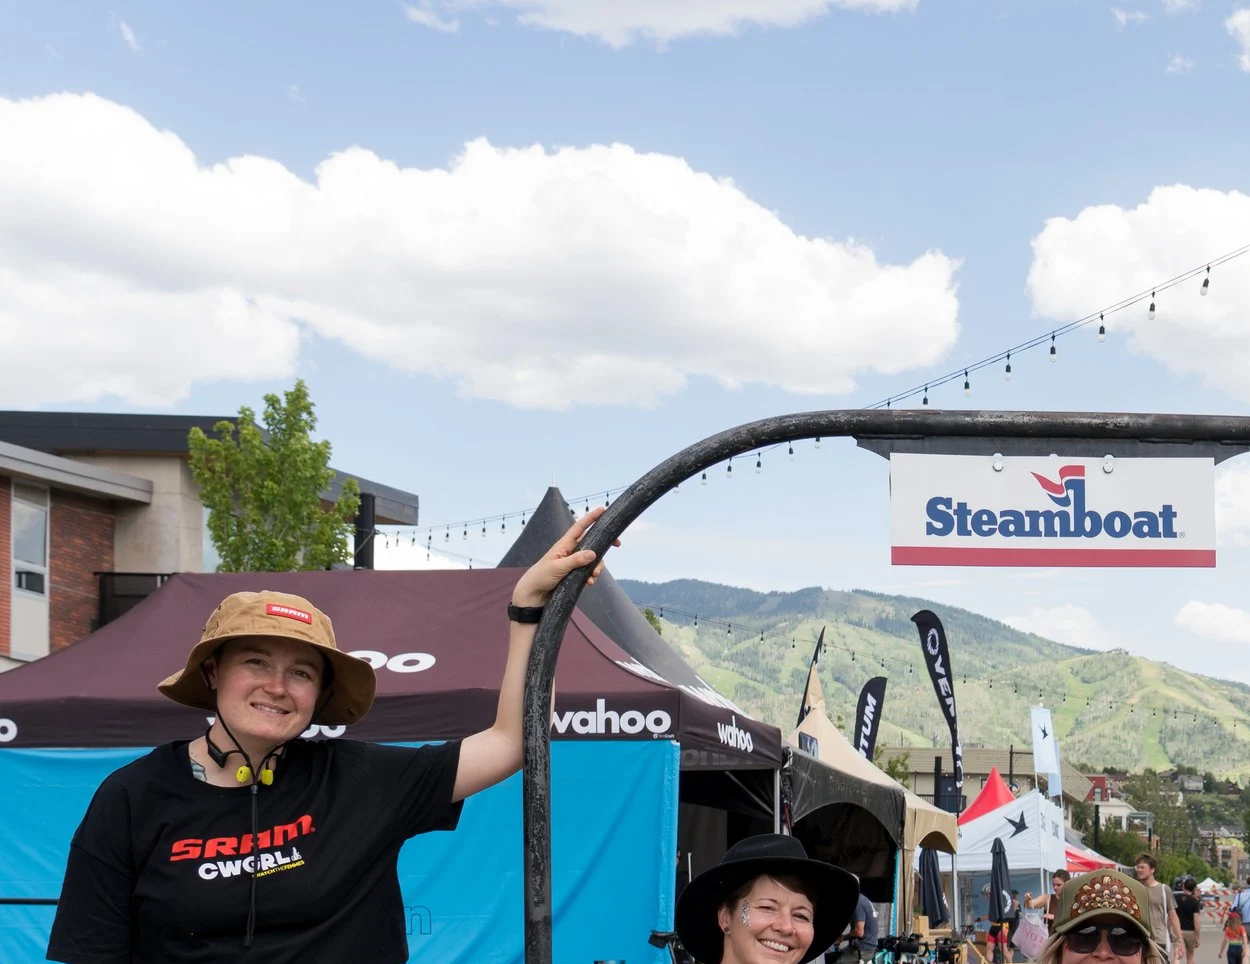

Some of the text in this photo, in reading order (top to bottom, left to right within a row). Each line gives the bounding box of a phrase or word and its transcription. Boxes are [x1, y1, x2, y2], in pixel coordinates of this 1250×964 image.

[924, 480, 1178, 538] Steamboat
[271, 605, 309, 618] SRAM
[717, 715, 754, 752] wahoo
[170, 814, 314, 862] SRAM
